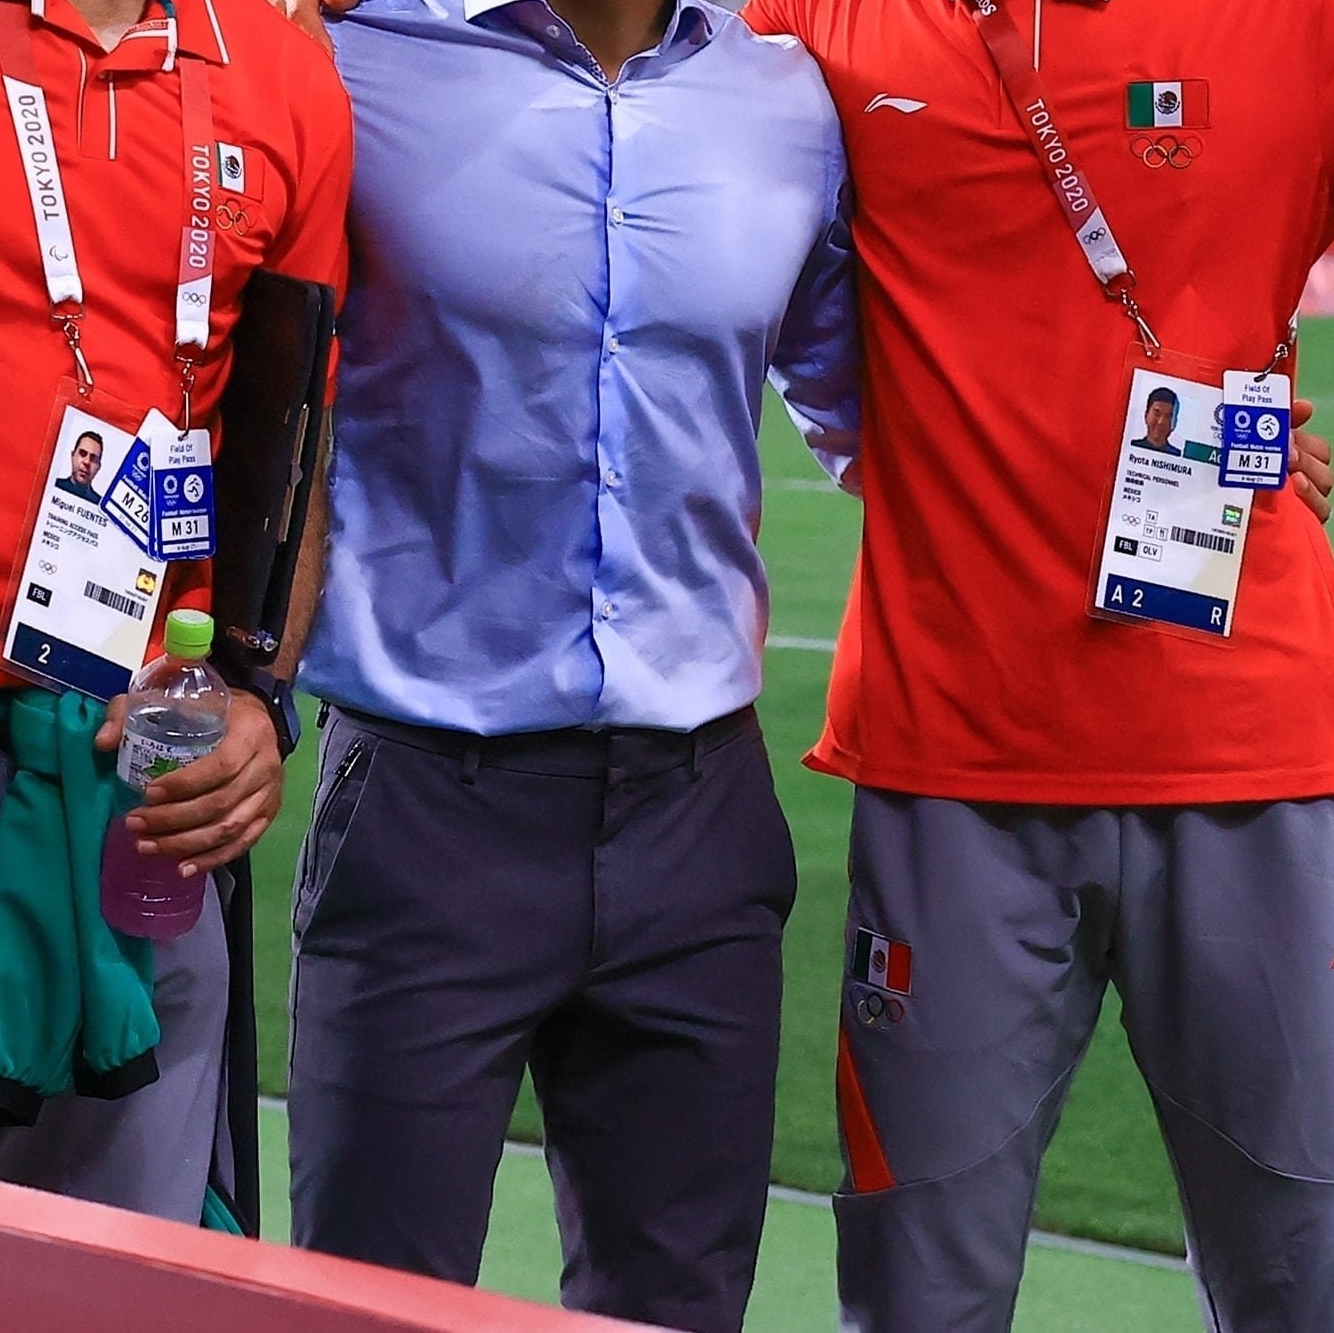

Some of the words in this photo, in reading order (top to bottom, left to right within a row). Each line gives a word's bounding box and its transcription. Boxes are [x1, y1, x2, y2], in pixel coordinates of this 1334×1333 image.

[18, 95, 45, 146] 2020
[1026, 97, 1066, 163] TOKYO
[1055, 163, 1089, 212] 2020
[31, 151, 59, 221] TOKYO
[191, 145, 211, 212] TOKYO
[188, 215, 210, 269] 2020
[1129, 453, 1149, 466] Ryota
[1151, 459, 1192, 476] NISHIMURA
[1238, 454, 1250, 468] M
[1254, 455, 1269, 469] 31
[51, 495, 76, 513] Miguel
[76, 506, 108, 528] FUENTES
[122, 491, 135, 509] M
[134, 504, 149, 524] 26
[171, 521, 182, 536] M
[185, 520, 199, 535] 31
[1119, 539, 1134, 552] FBL
[1142, 545, 1158, 556] OLV
[32, 587, 47, 601] FBL
[1110, 584, 1123, 604] A
[1131, 588, 1144, 608] 2
[1210, 606, 1222, 626] R
[38, 643, 51, 664] 2
